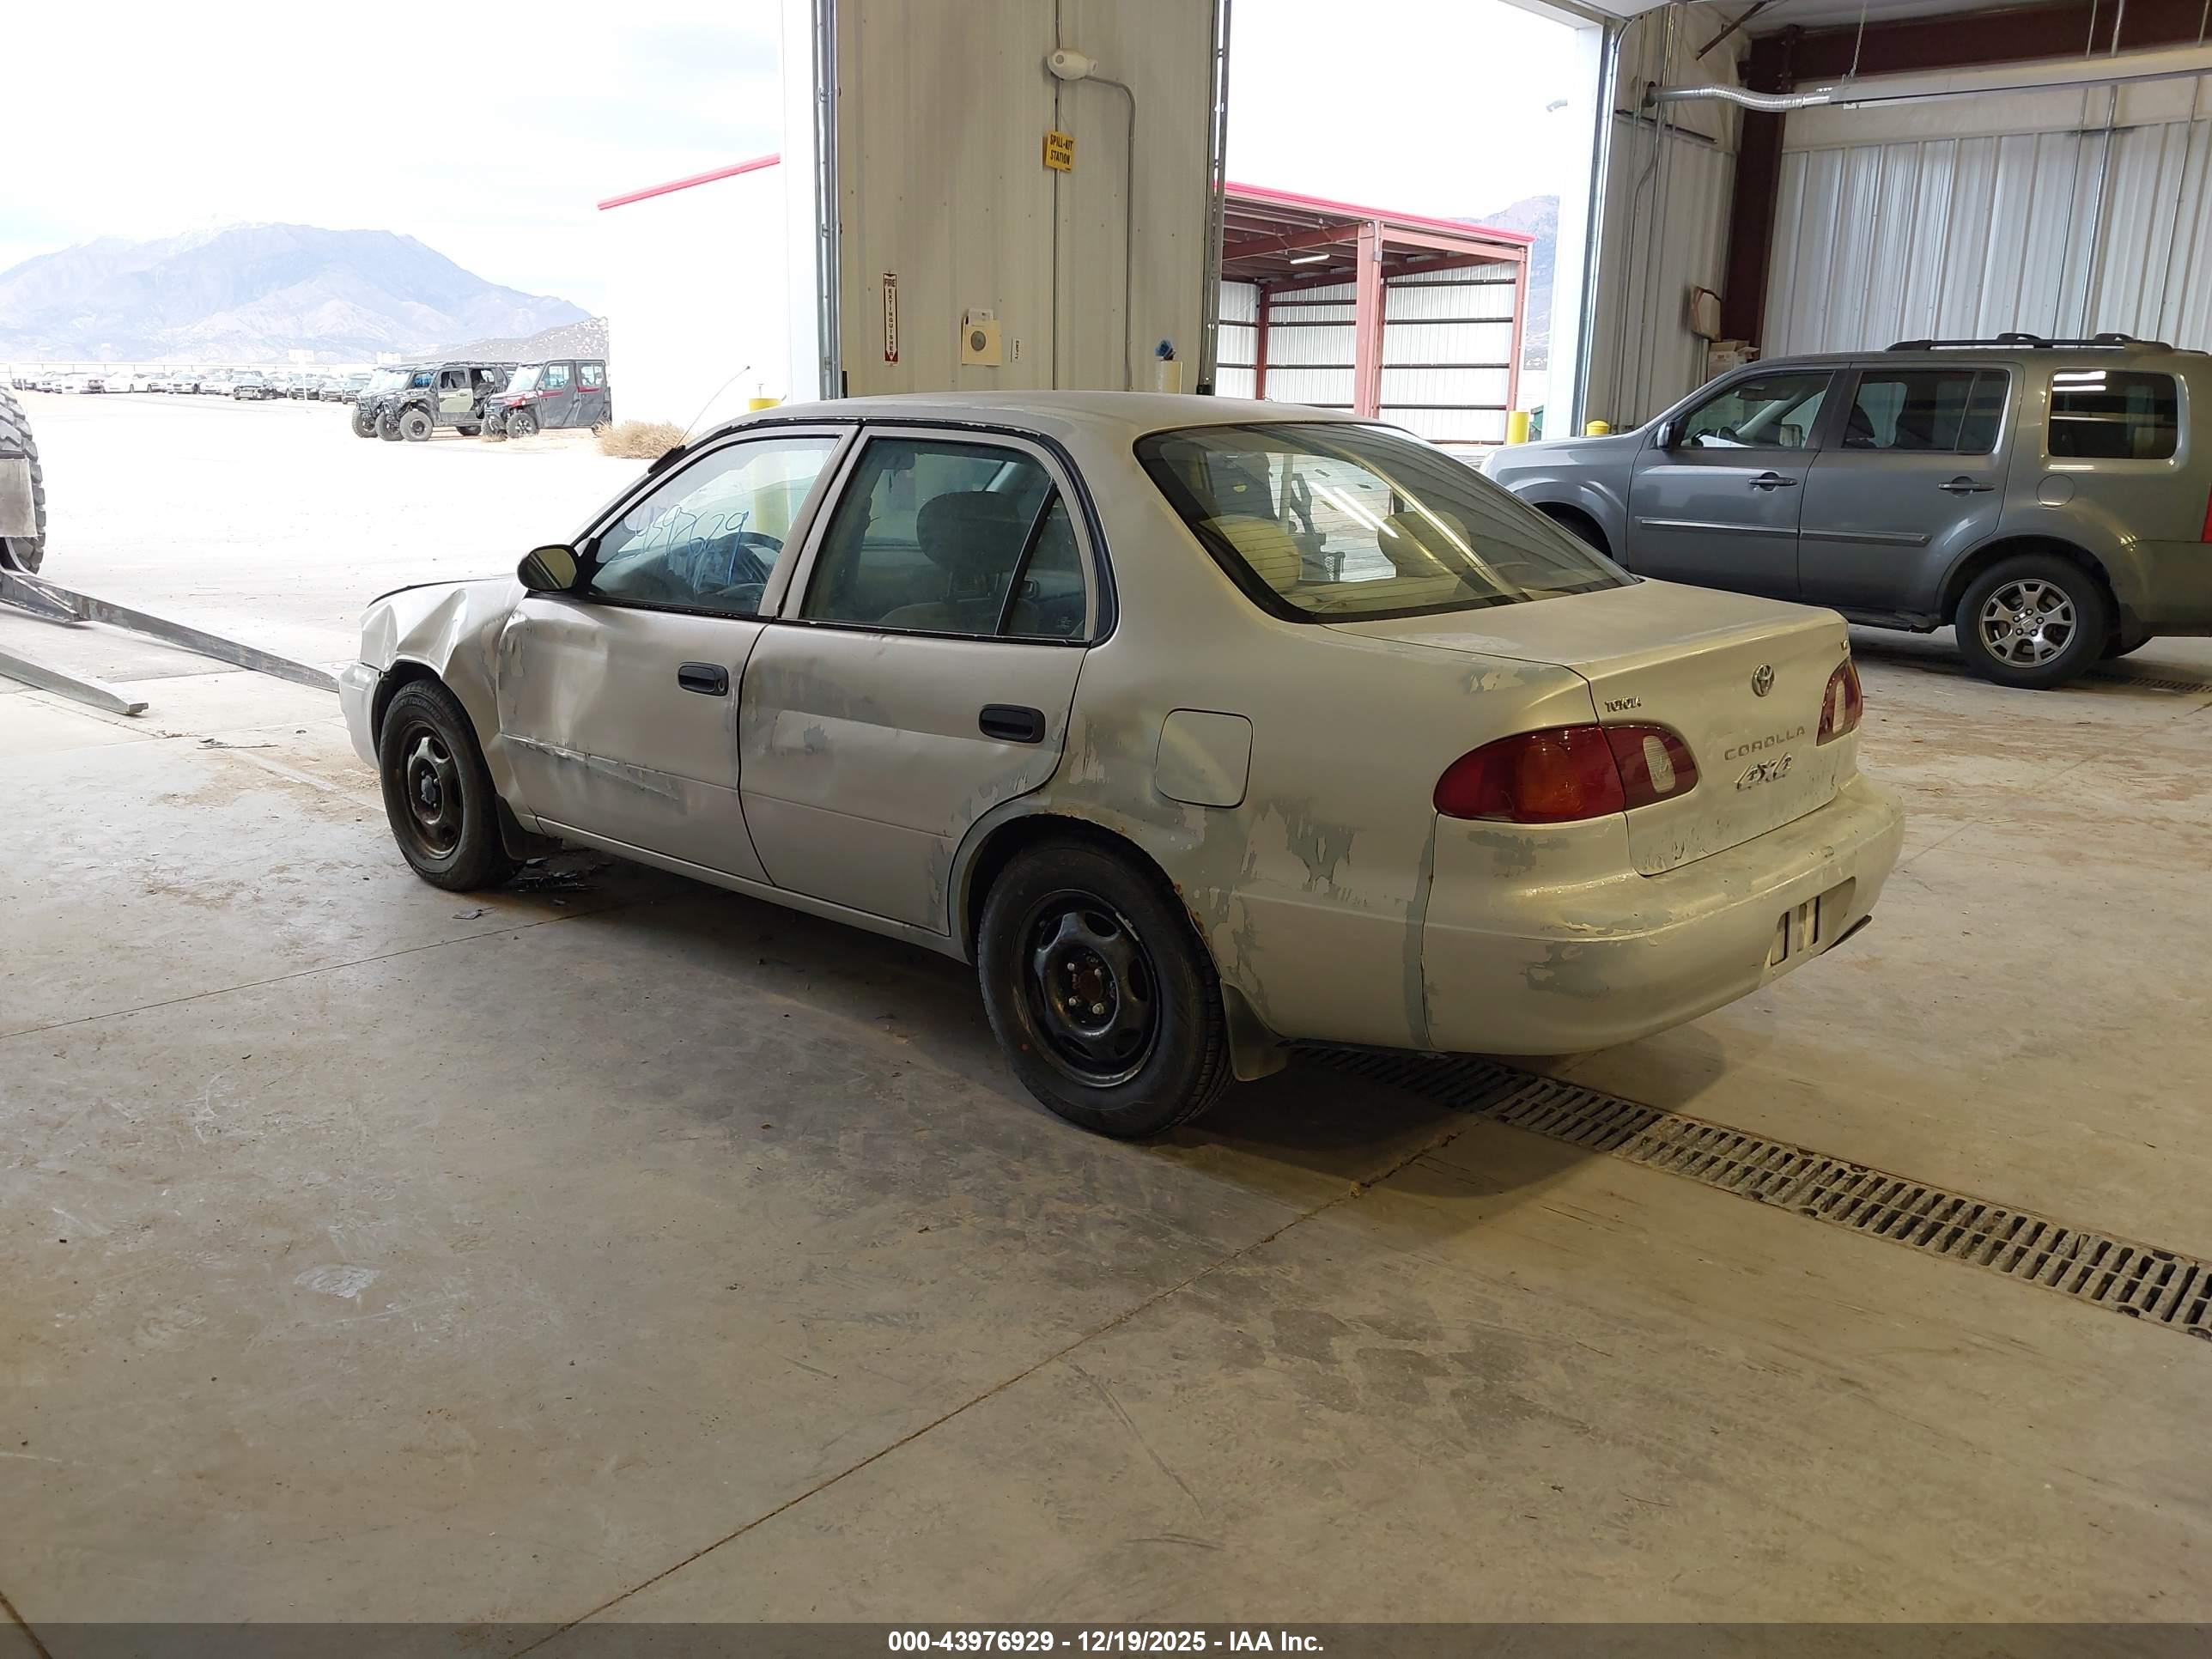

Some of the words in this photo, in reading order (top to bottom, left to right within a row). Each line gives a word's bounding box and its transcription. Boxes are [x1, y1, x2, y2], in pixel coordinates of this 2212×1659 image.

[1050, 149, 1071, 165] STATION
[884, 278, 896, 288] FIRE
[1604, 696, 1642, 713] TOYOTA
[1724, 726, 1805, 761] COROLLA
